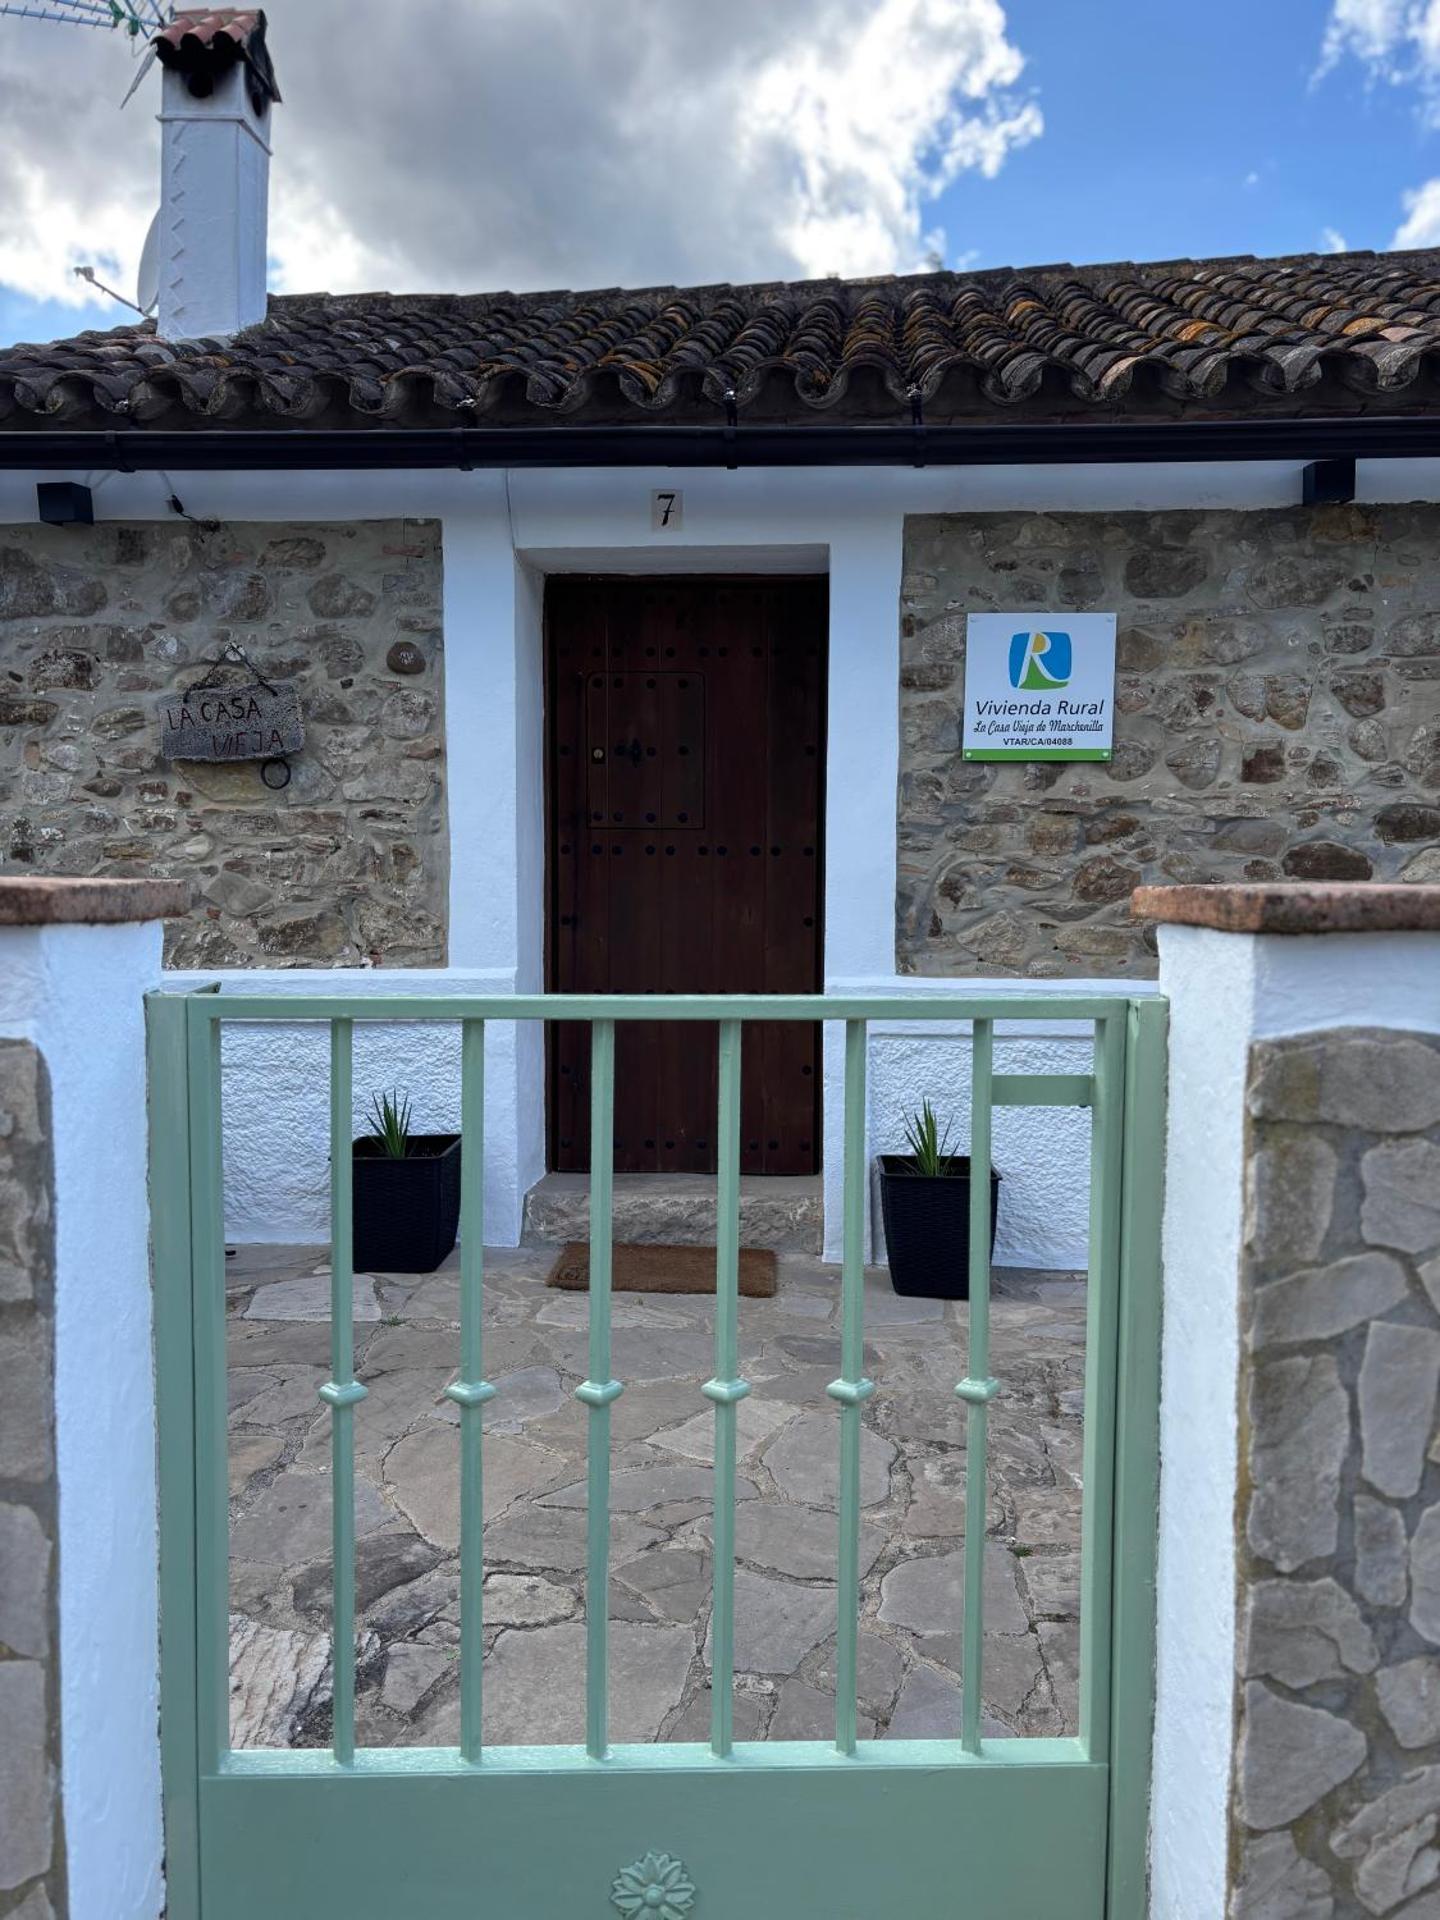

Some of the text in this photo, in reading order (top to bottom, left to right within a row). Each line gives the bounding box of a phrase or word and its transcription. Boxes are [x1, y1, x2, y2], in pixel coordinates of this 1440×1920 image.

[656, 493, 676, 527] 7
[167, 697, 262, 730] LA CASA
[975, 699, 1105, 716] Vivienda Rural
[973, 719, 1104, 736] La Casa Vieja de Marchenilla
[212, 730, 285, 756] VIEJA
